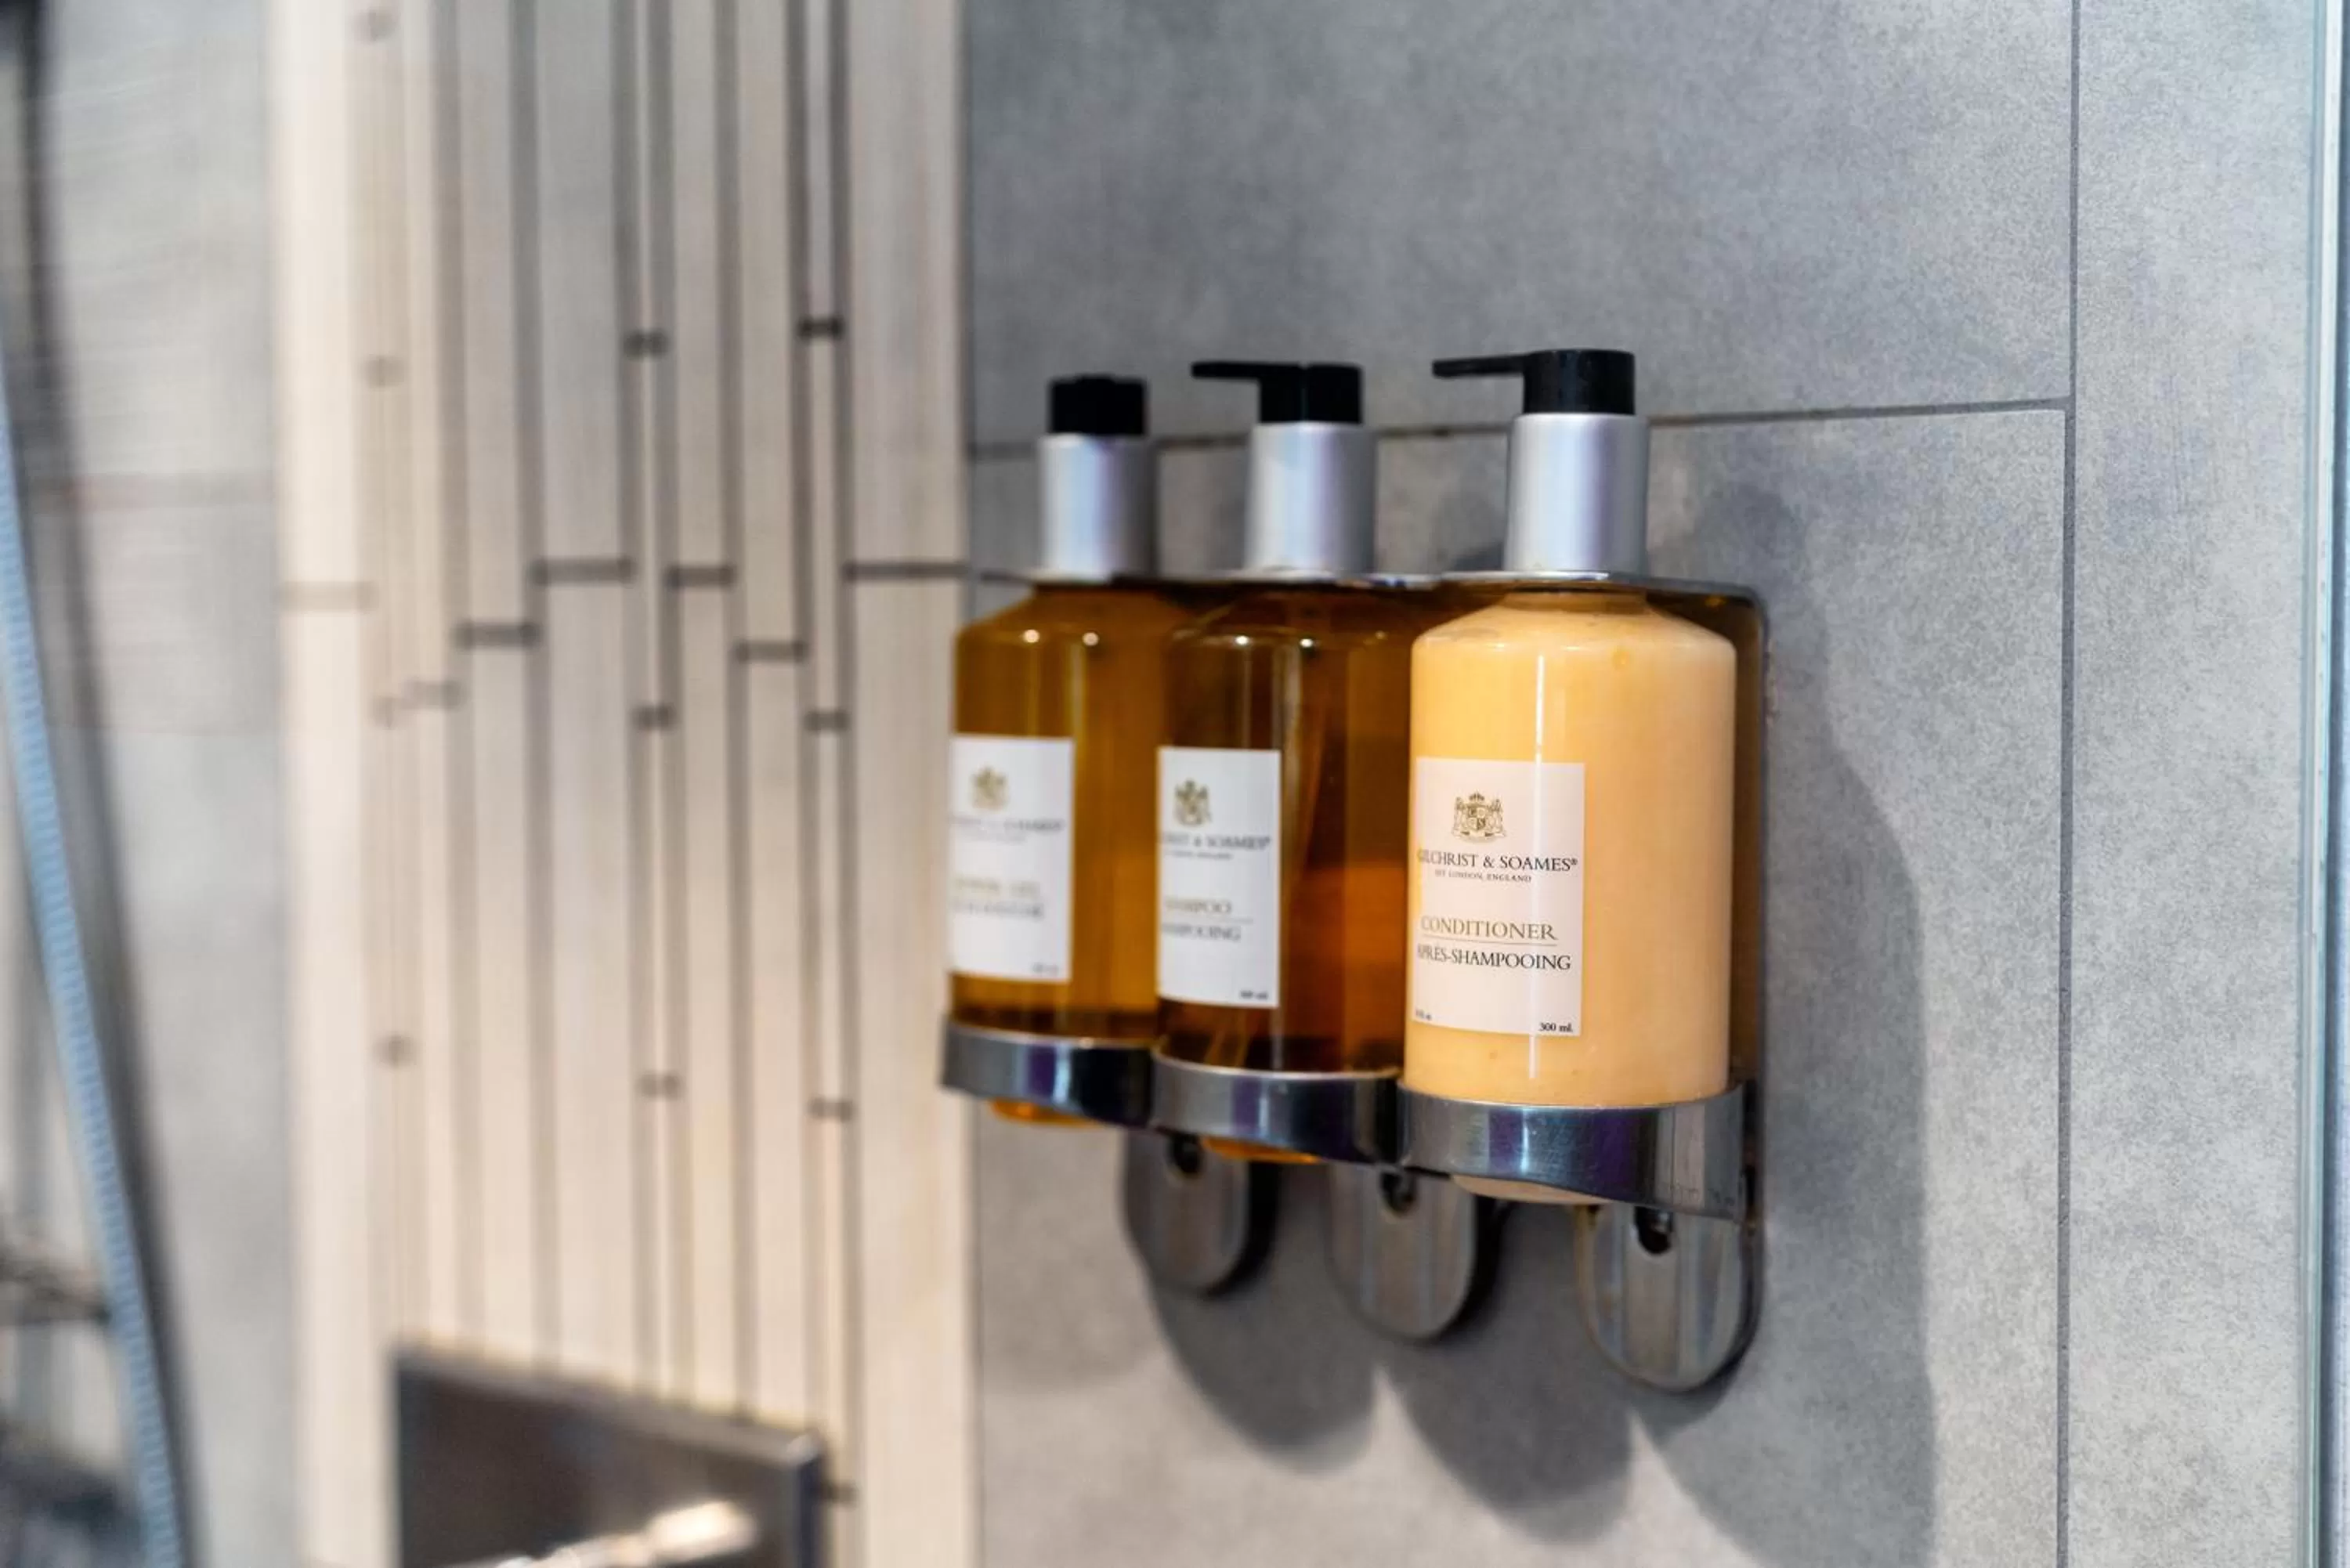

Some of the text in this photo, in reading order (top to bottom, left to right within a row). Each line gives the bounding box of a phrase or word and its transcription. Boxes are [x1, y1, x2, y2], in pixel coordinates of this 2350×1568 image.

[1483, 854, 1495, 869] &
[1486, 873, 1532, 883] ENGLAND
[1421, 916, 1559, 941] CONDITIONER
[1538, 1021, 1557, 1031] 300
